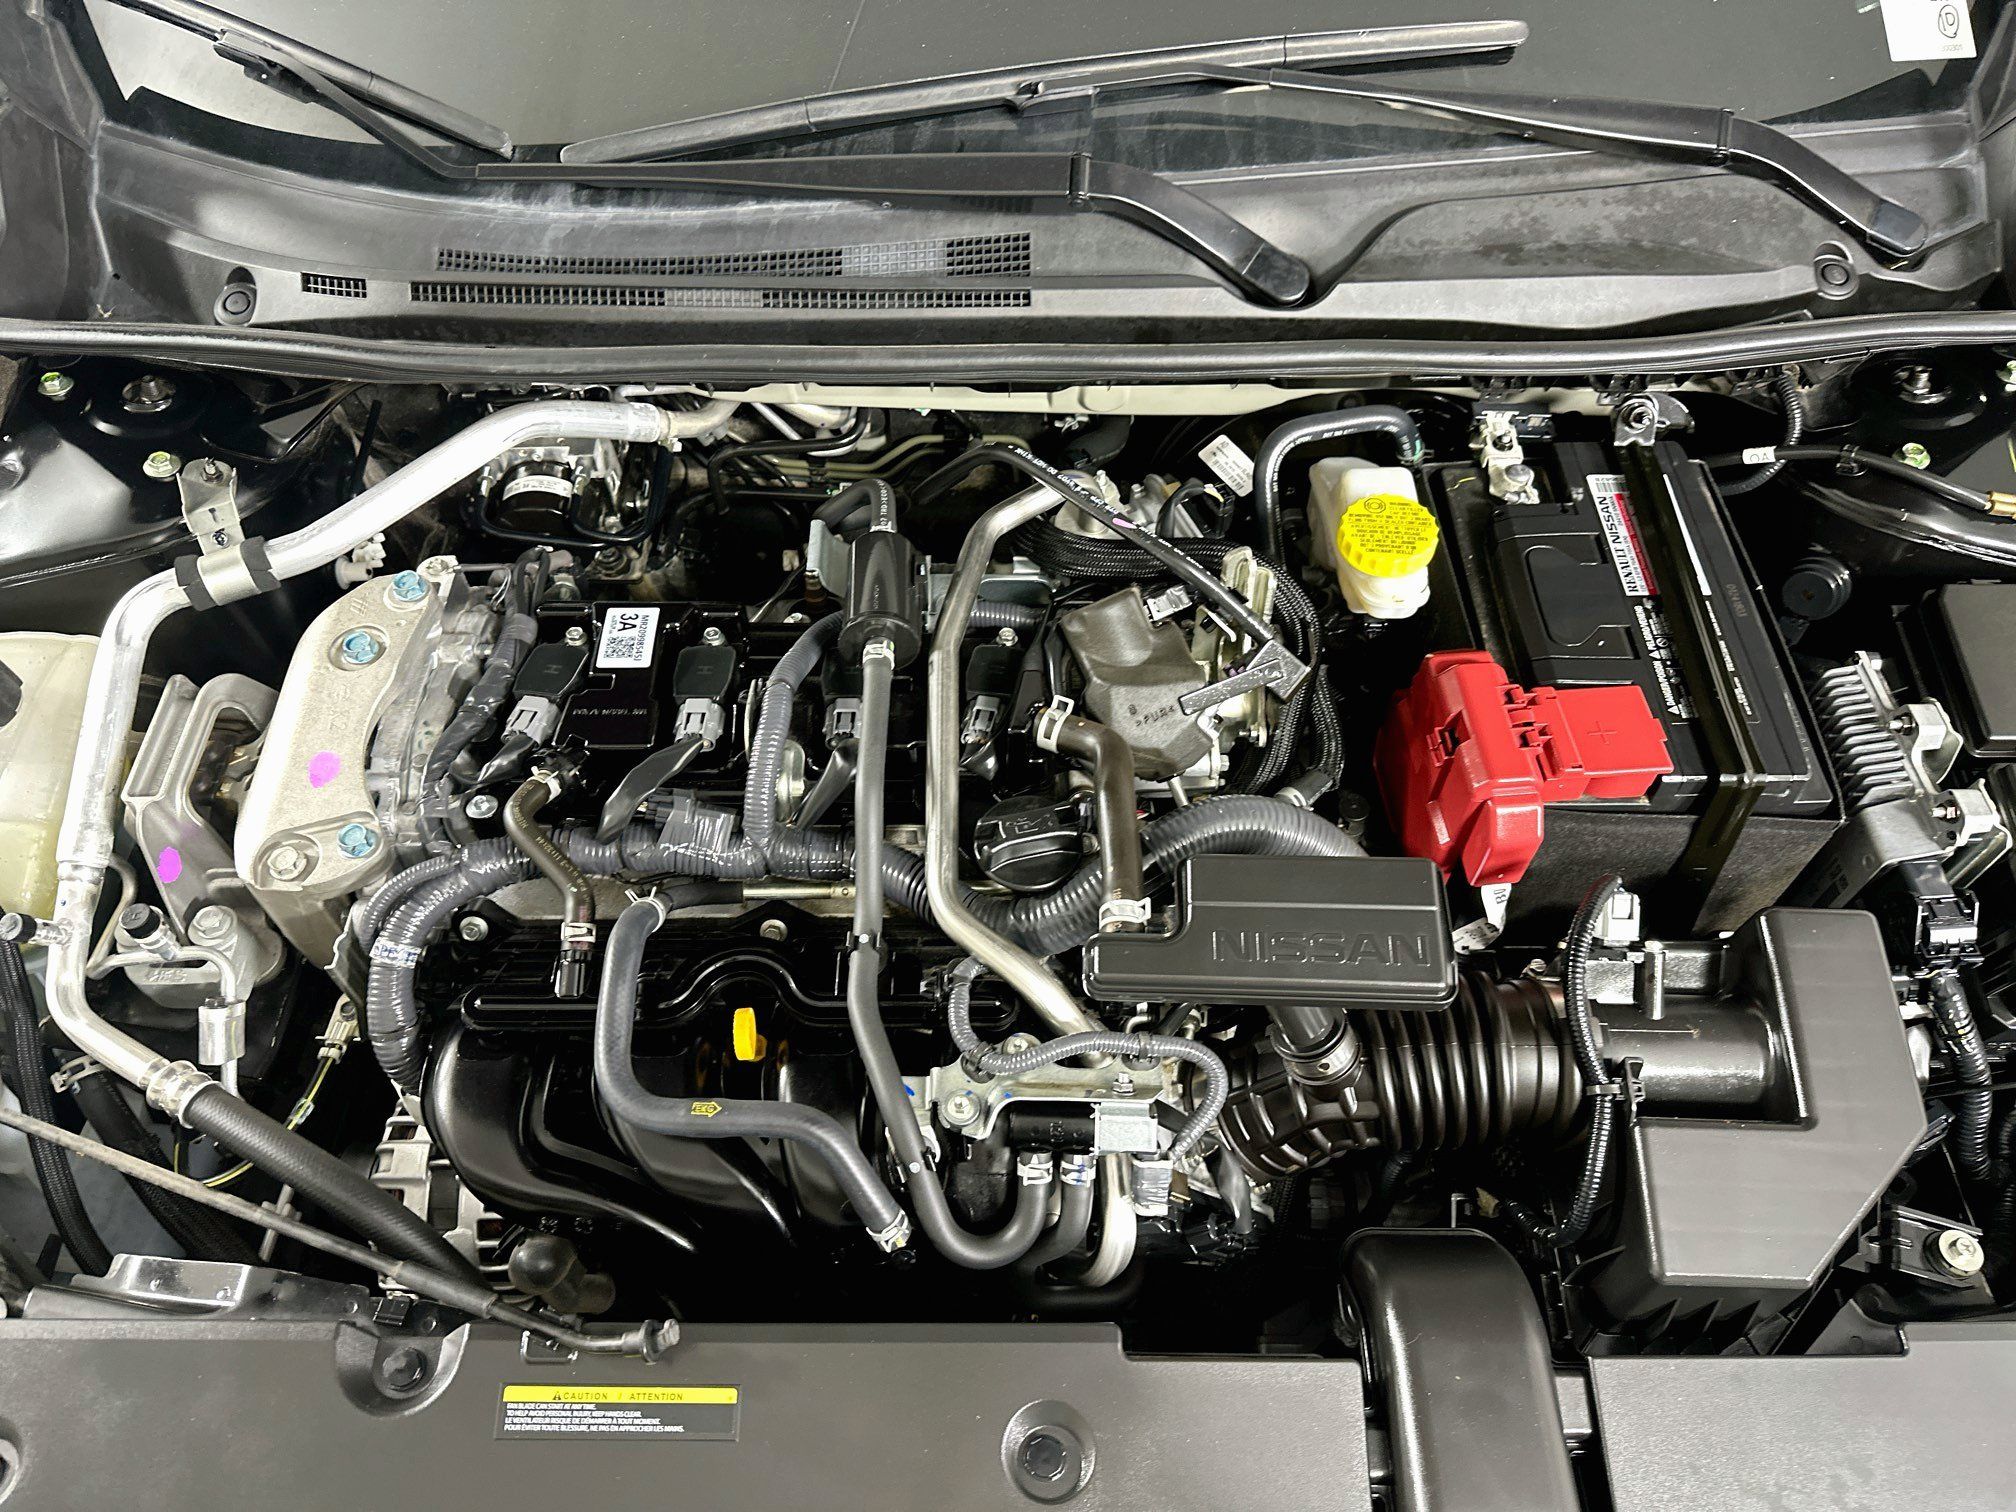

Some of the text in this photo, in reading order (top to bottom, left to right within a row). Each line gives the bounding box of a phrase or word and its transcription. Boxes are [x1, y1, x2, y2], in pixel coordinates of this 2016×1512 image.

[1597, 496, 1623, 545] NISSAN
[1611, 541, 1638, 593] RENAULT
[618, 613, 638, 632] 3A
[1212, 930, 1430, 967] NISSAN
[563, 1392, 608, 1401] CAUTION
[630, 1392, 683, 1401] ATTENTION
